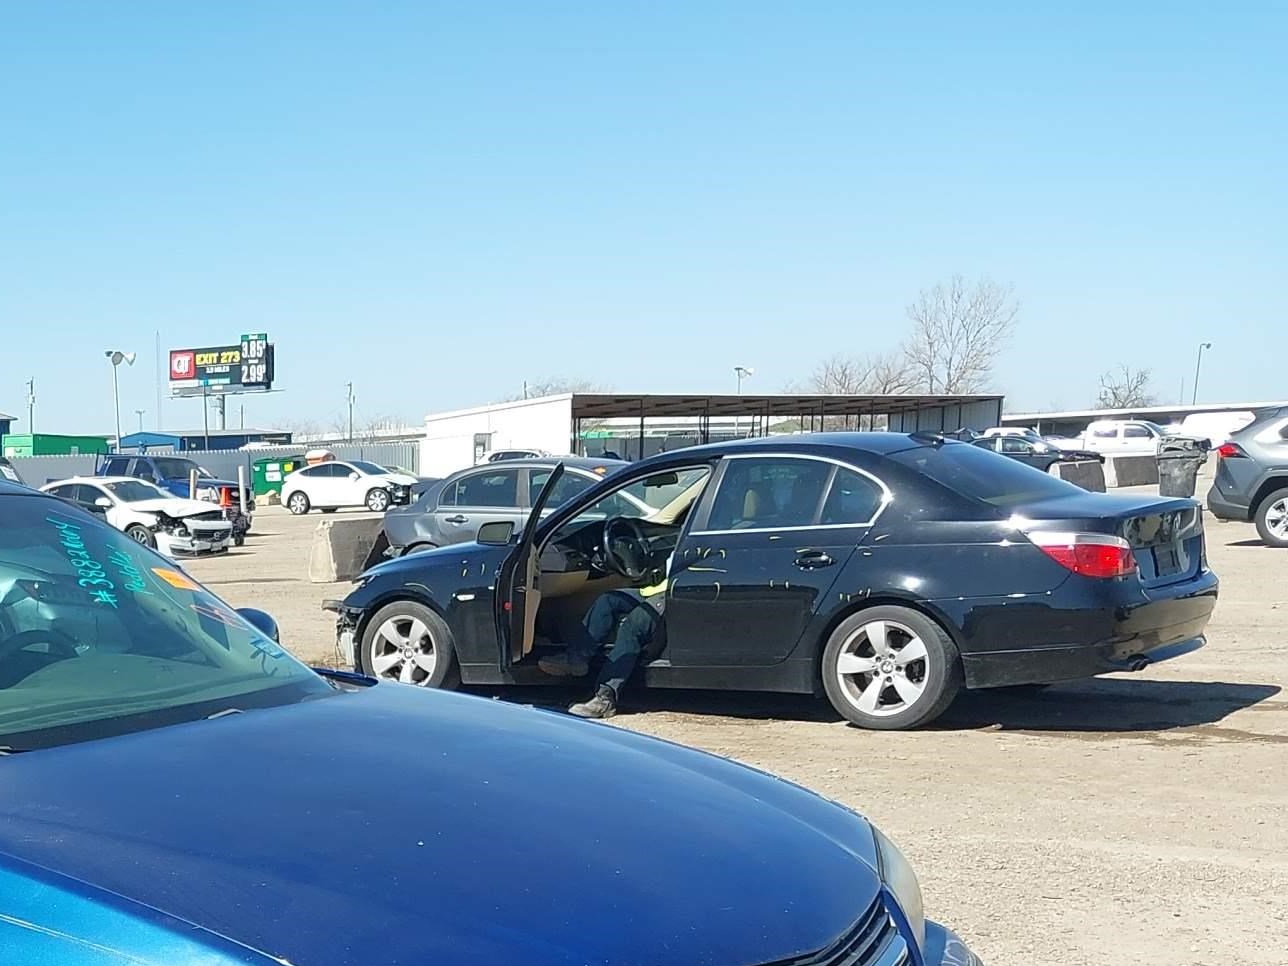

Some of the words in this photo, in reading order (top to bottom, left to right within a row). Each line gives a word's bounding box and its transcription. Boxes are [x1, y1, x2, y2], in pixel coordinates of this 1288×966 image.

[175, 357, 190, 374] QT
[196, 353, 219, 365] EXIT
[221, 351, 240, 363] 273
